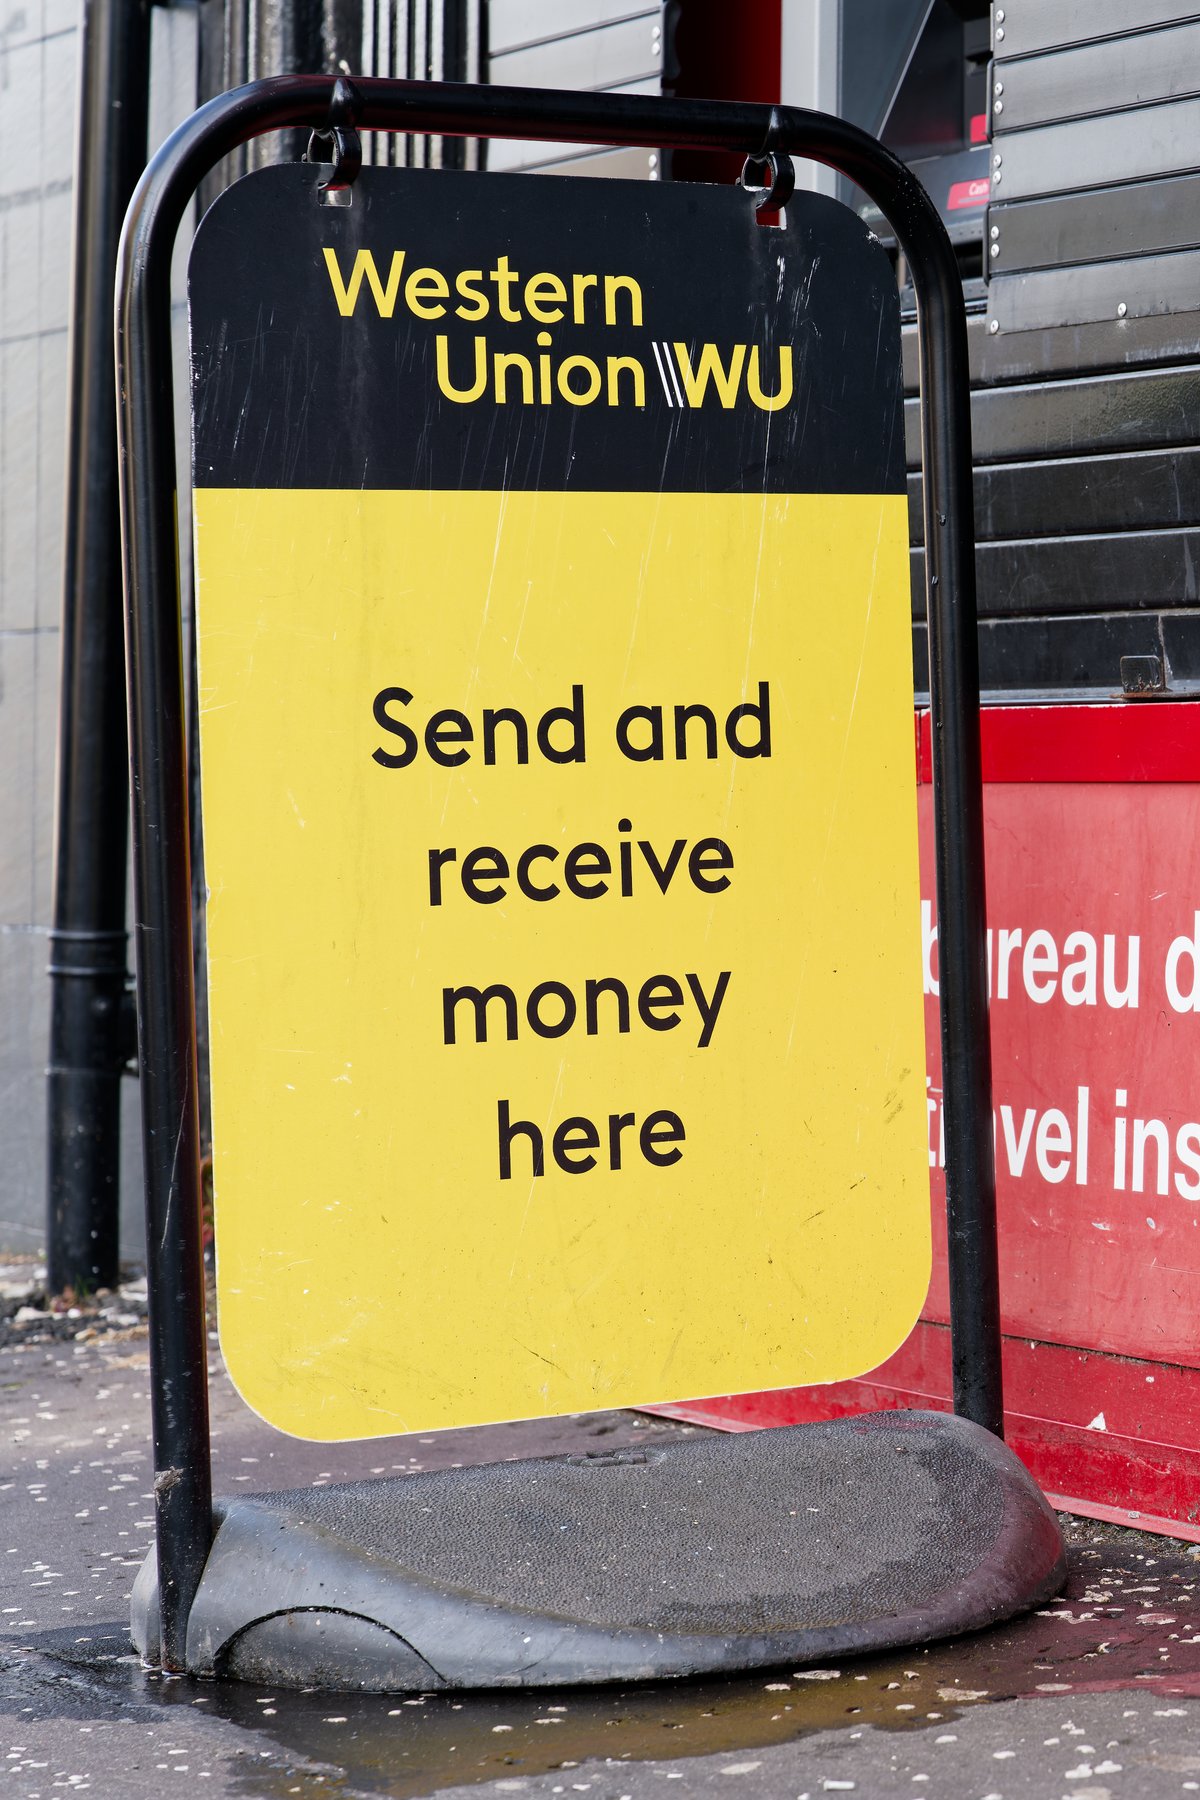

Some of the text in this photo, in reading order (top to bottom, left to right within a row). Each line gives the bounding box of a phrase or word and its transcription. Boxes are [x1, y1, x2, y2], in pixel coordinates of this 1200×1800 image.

[322, 247, 643, 327] Western
[435, 331, 794, 412] Union WU
[371, 681, 772, 769] Send and
[428, 818, 734, 907] receive
[920, 899, 1141, 1009] breau
[442, 971, 732, 1048] money
[497, 1099, 686, 1180] here
